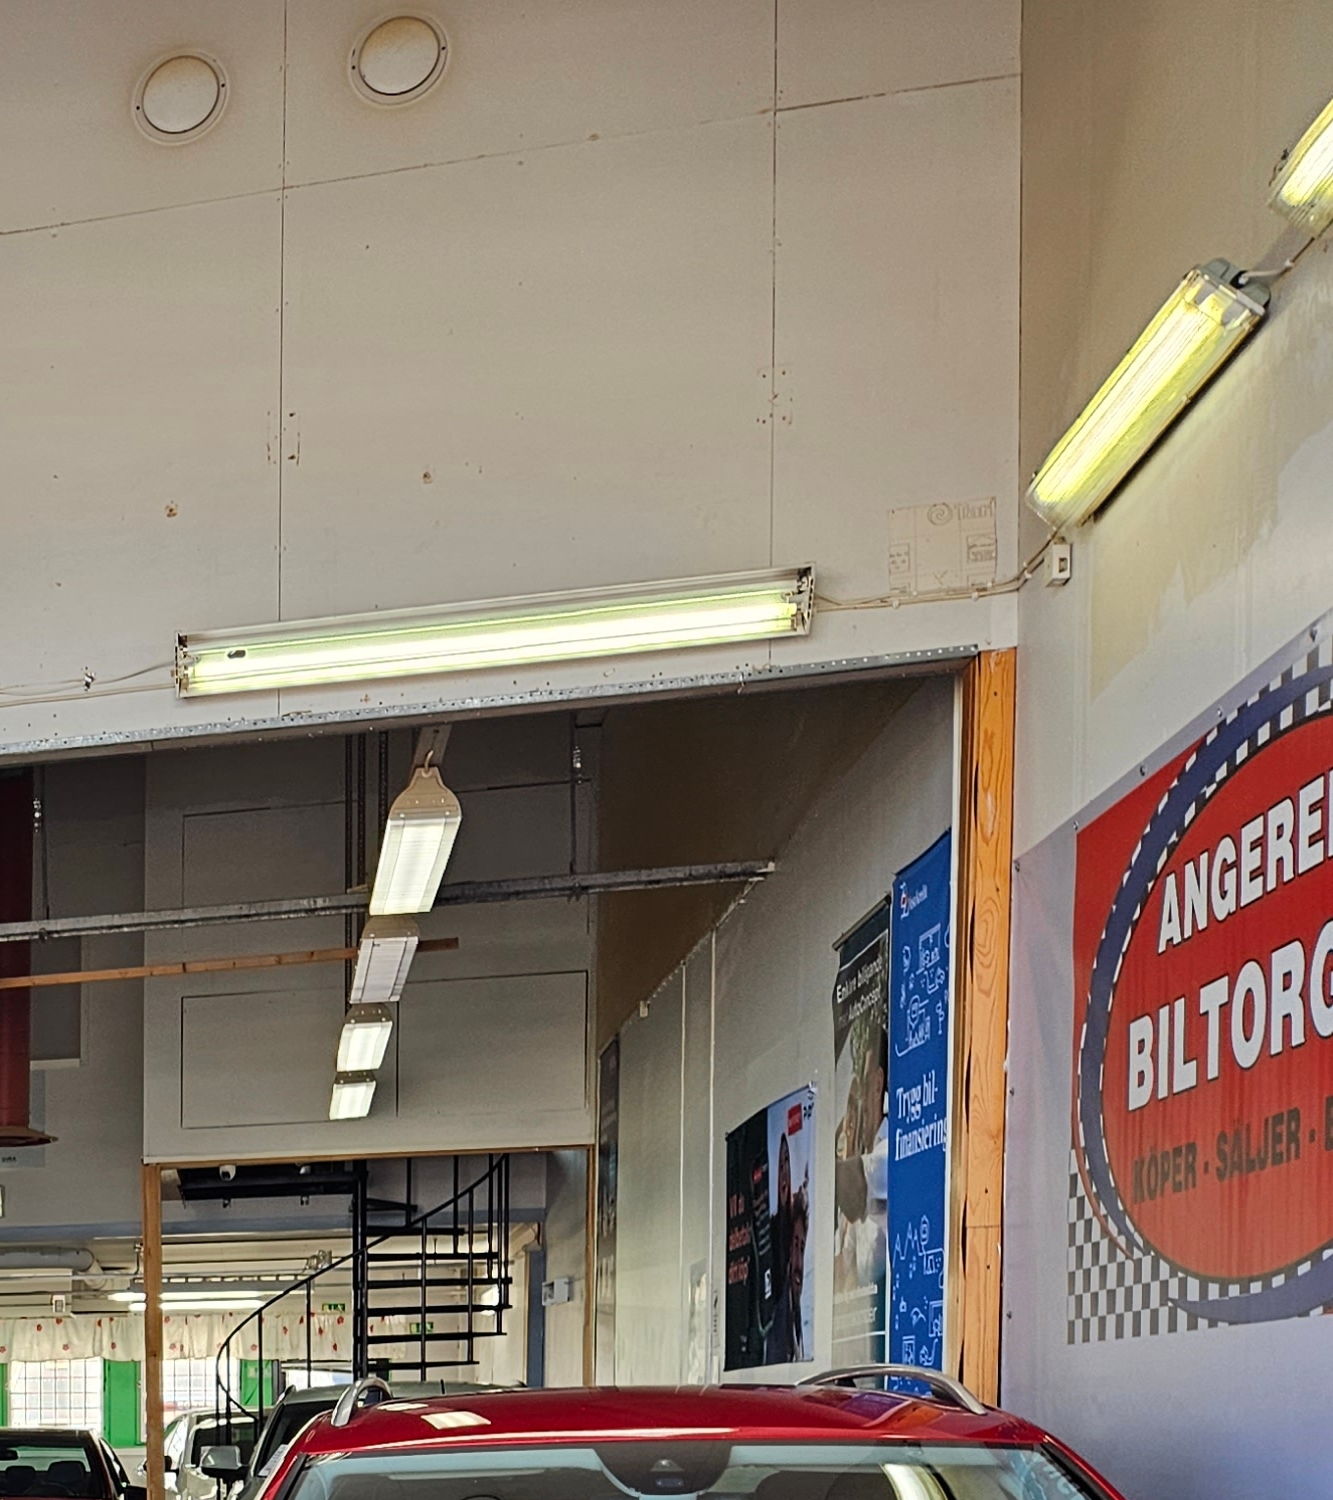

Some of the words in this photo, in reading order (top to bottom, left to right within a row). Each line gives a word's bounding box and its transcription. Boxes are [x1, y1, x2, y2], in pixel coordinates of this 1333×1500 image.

[1157, 765, 1333, 955] ANGERE
[895, 1083, 922, 1125] Trygg
[922, 1070, 939, 1112] bil-
[894, 1114, 948, 1162] finansiering
[1132, 1140, 1198, 1205] KÖPER
[1215, 1105, 1302, 1184] SÄLJER
